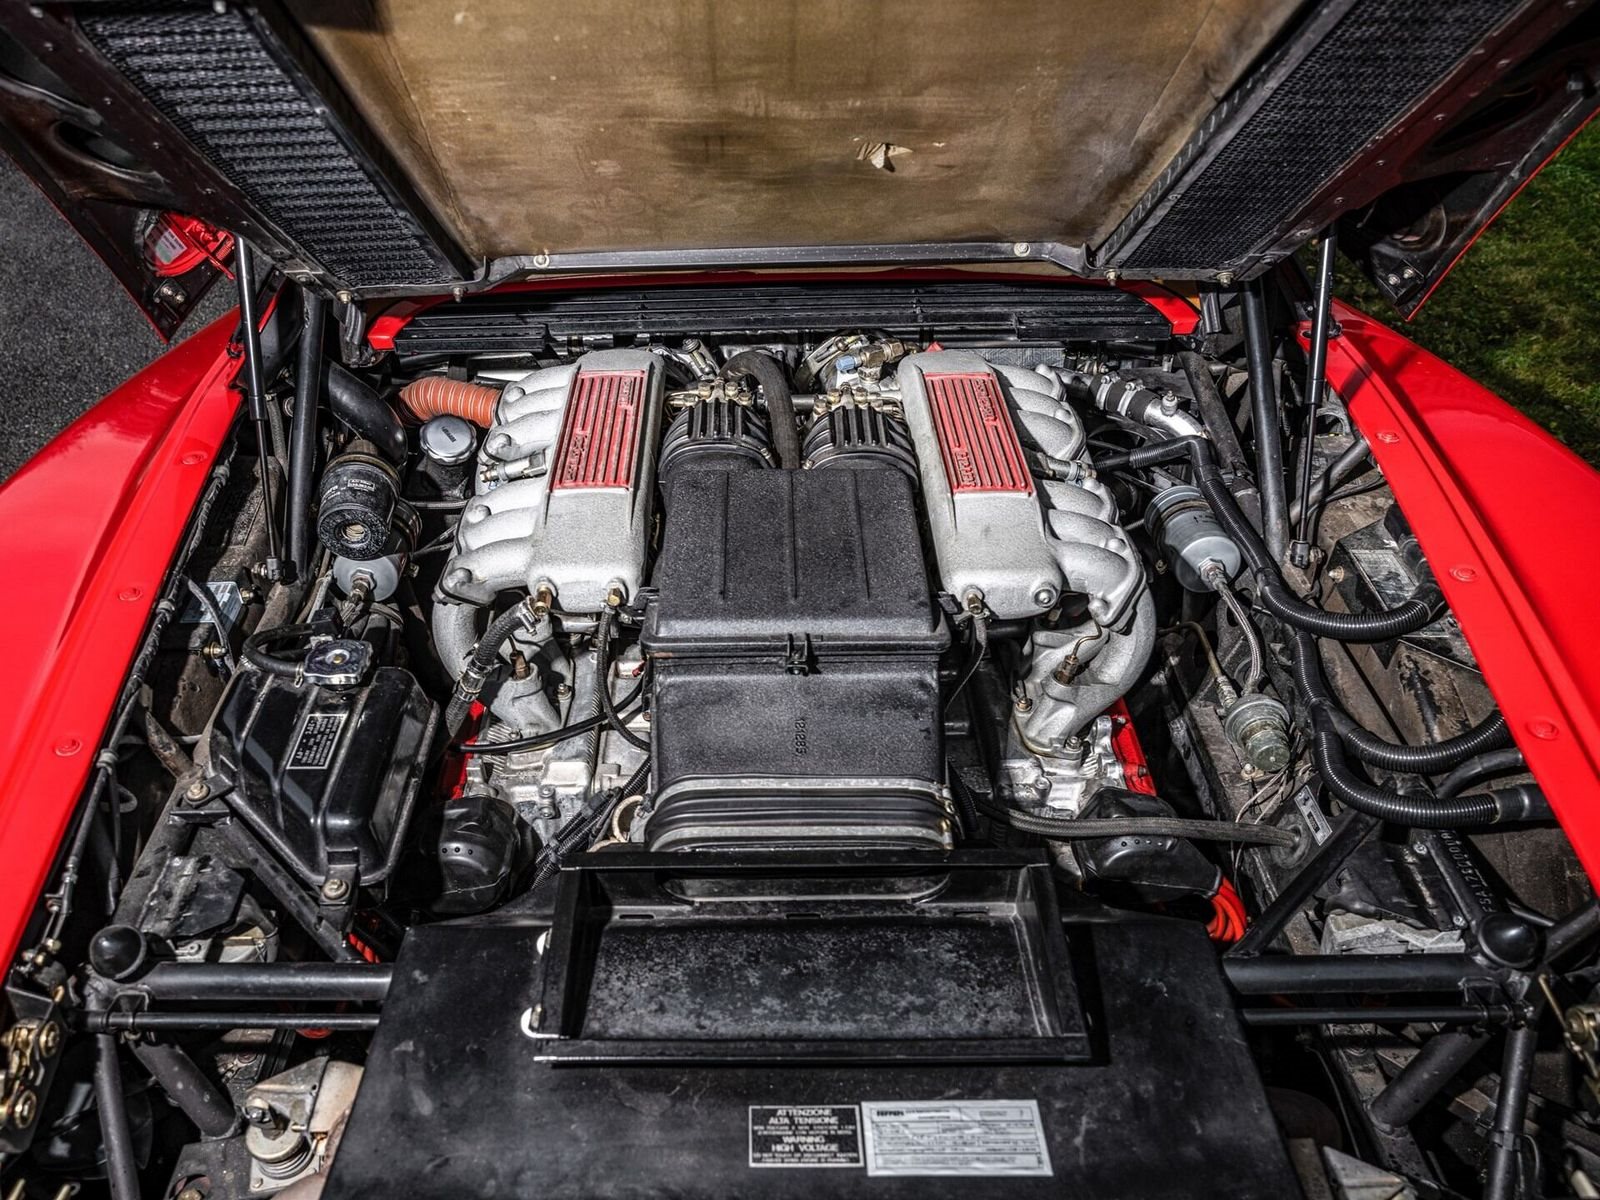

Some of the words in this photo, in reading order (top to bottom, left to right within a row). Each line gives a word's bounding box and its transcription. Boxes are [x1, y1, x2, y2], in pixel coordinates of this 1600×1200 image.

[777, 1109, 832, 1117] ATTENZIONE
[768, 1117, 791, 1125] ALTA
[793, 1116, 839, 1125] TENSIONE
[782, 1135, 825, 1143] WARNING
[771, 1144, 795, 1152] HIGH
[799, 1143, 839, 1152] VOLTAGE
